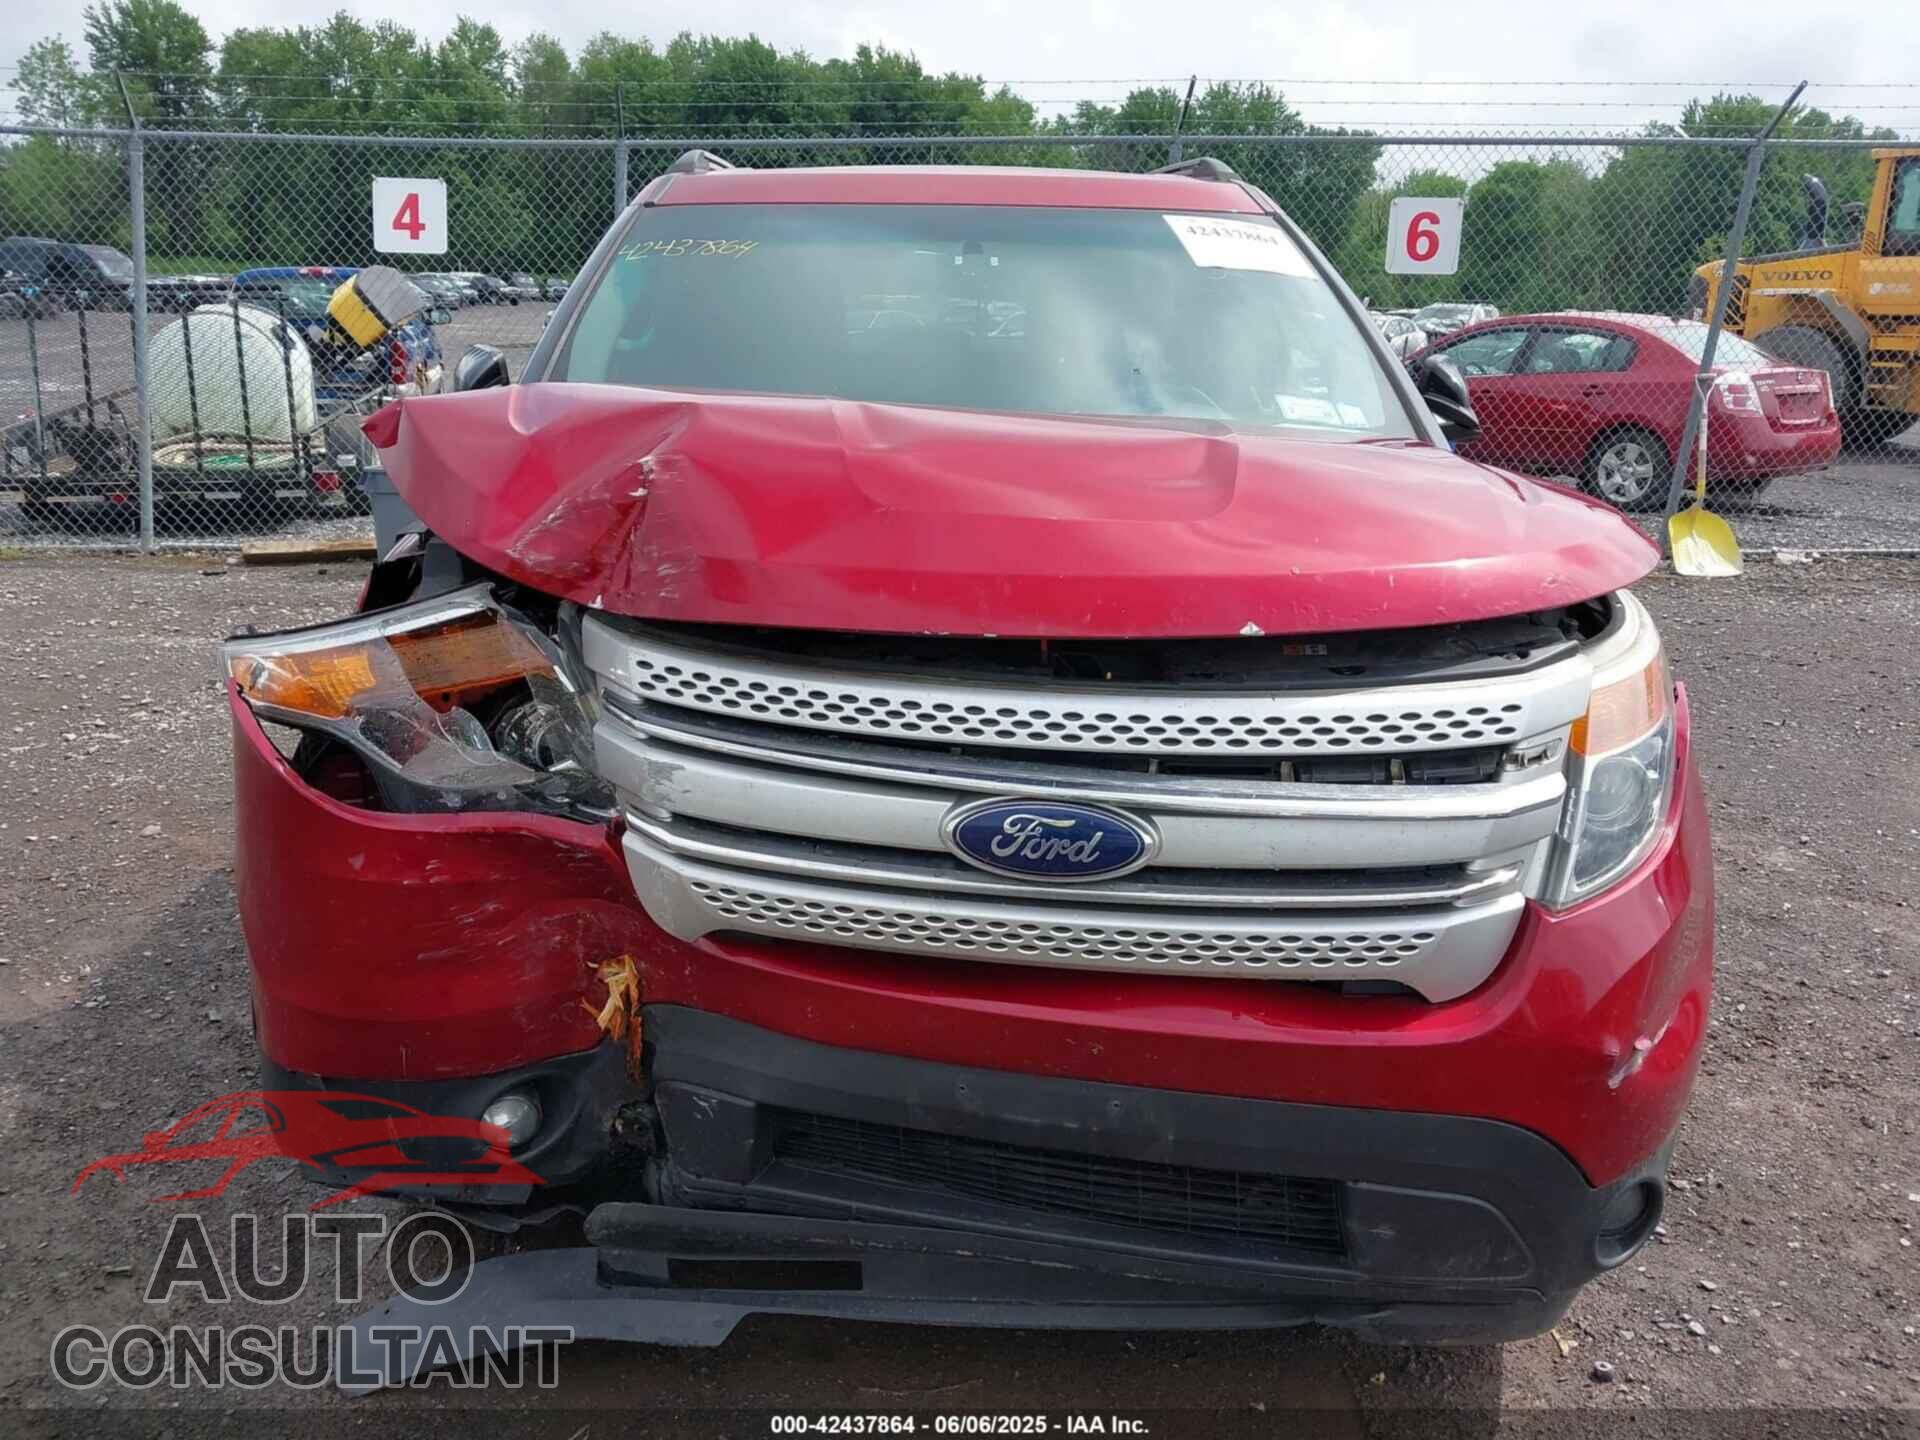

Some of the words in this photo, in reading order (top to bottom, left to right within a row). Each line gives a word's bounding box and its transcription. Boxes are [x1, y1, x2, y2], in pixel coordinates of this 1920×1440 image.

[392, 193, 426, 240] 4
[1407, 211, 1440, 262] 6
[618, 239, 760, 261] 42437864
[1761, 270, 1834, 282] VOLVO
[991, 814, 1103, 863] Ford
